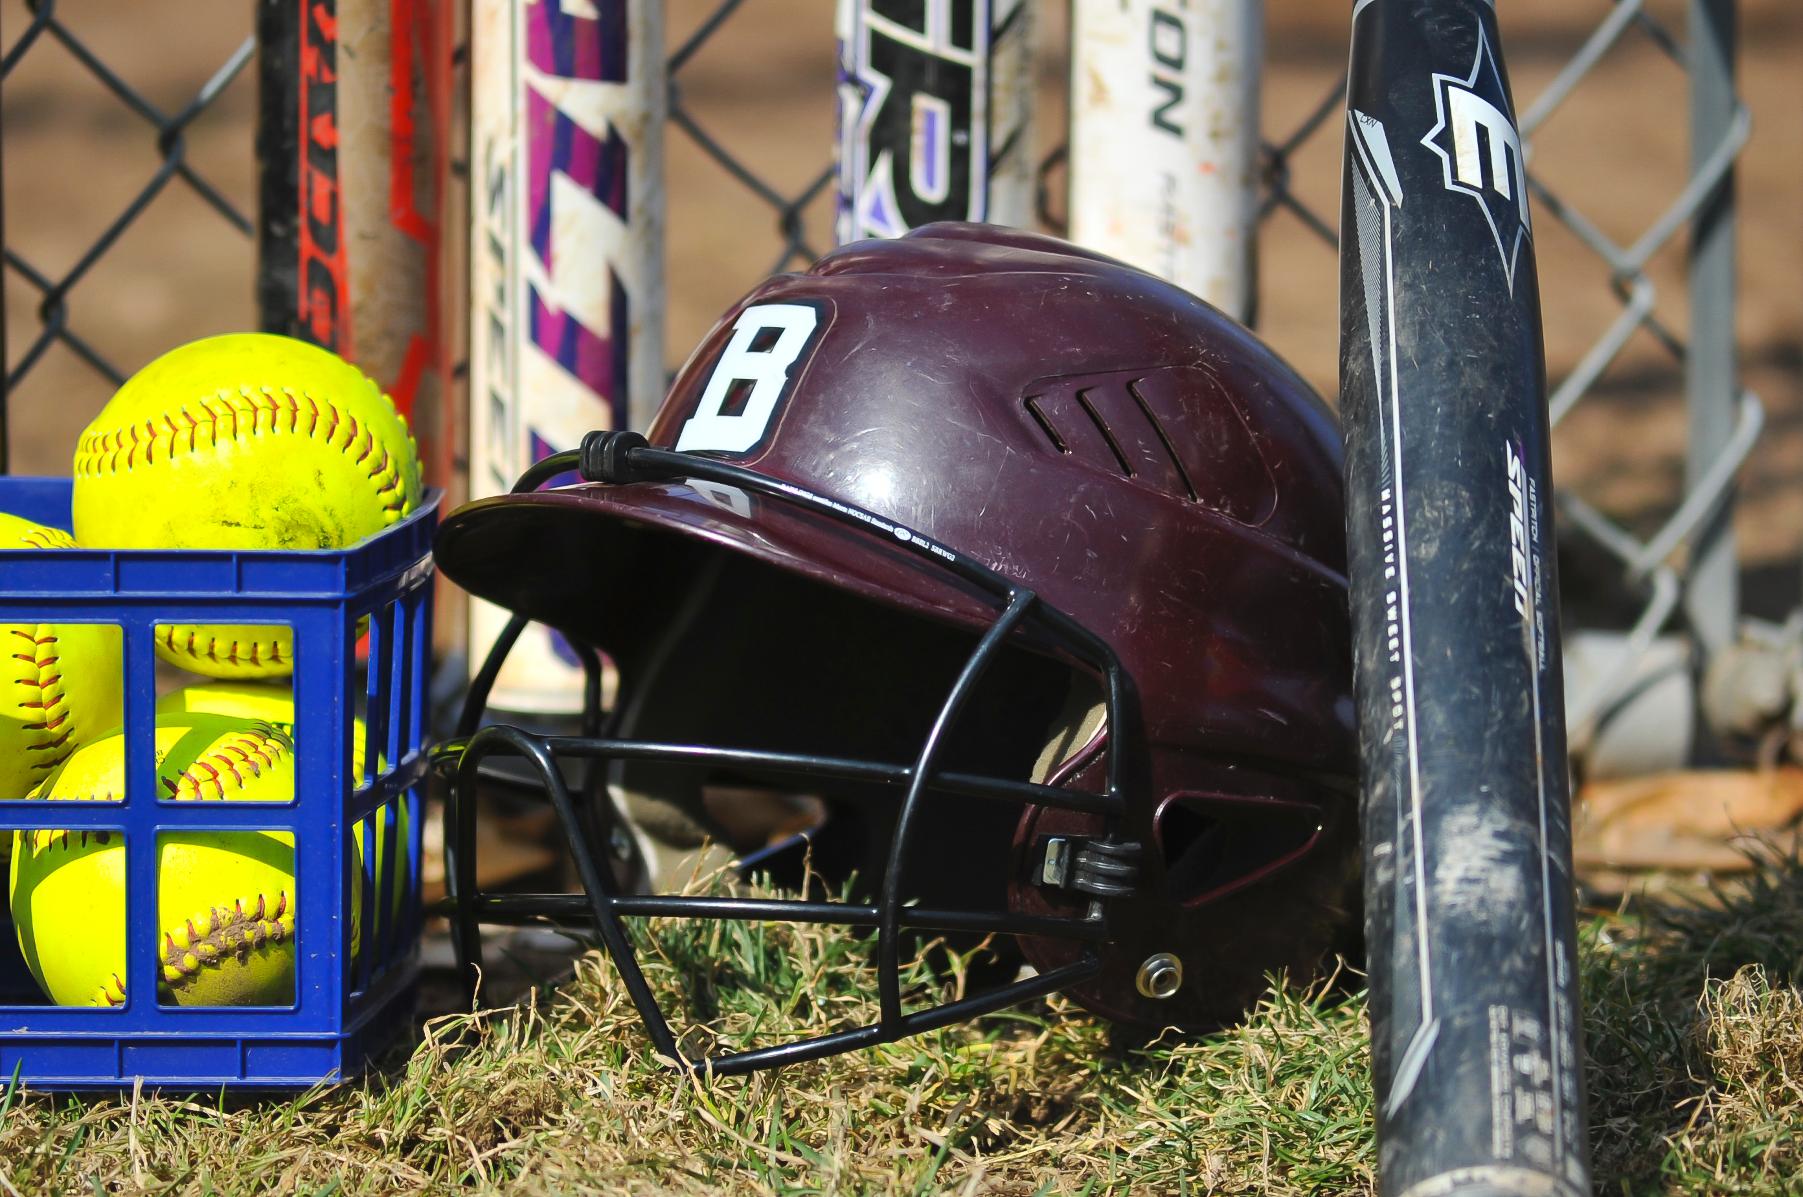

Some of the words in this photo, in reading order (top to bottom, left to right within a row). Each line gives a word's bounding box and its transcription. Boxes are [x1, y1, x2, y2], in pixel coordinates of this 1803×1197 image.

[674, 304, 818, 453] B
[1381, 488, 1395, 579] MASSIVE
[1529, 478, 1538, 543] FASTPITCH
[1532, 554, 1541, 605] OFFICIAL
[1386, 591, 1399, 662] SWEET
[1536, 611, 1545, 671] SOFTBALL
[1390, 676, 1403, 730] SPOT
